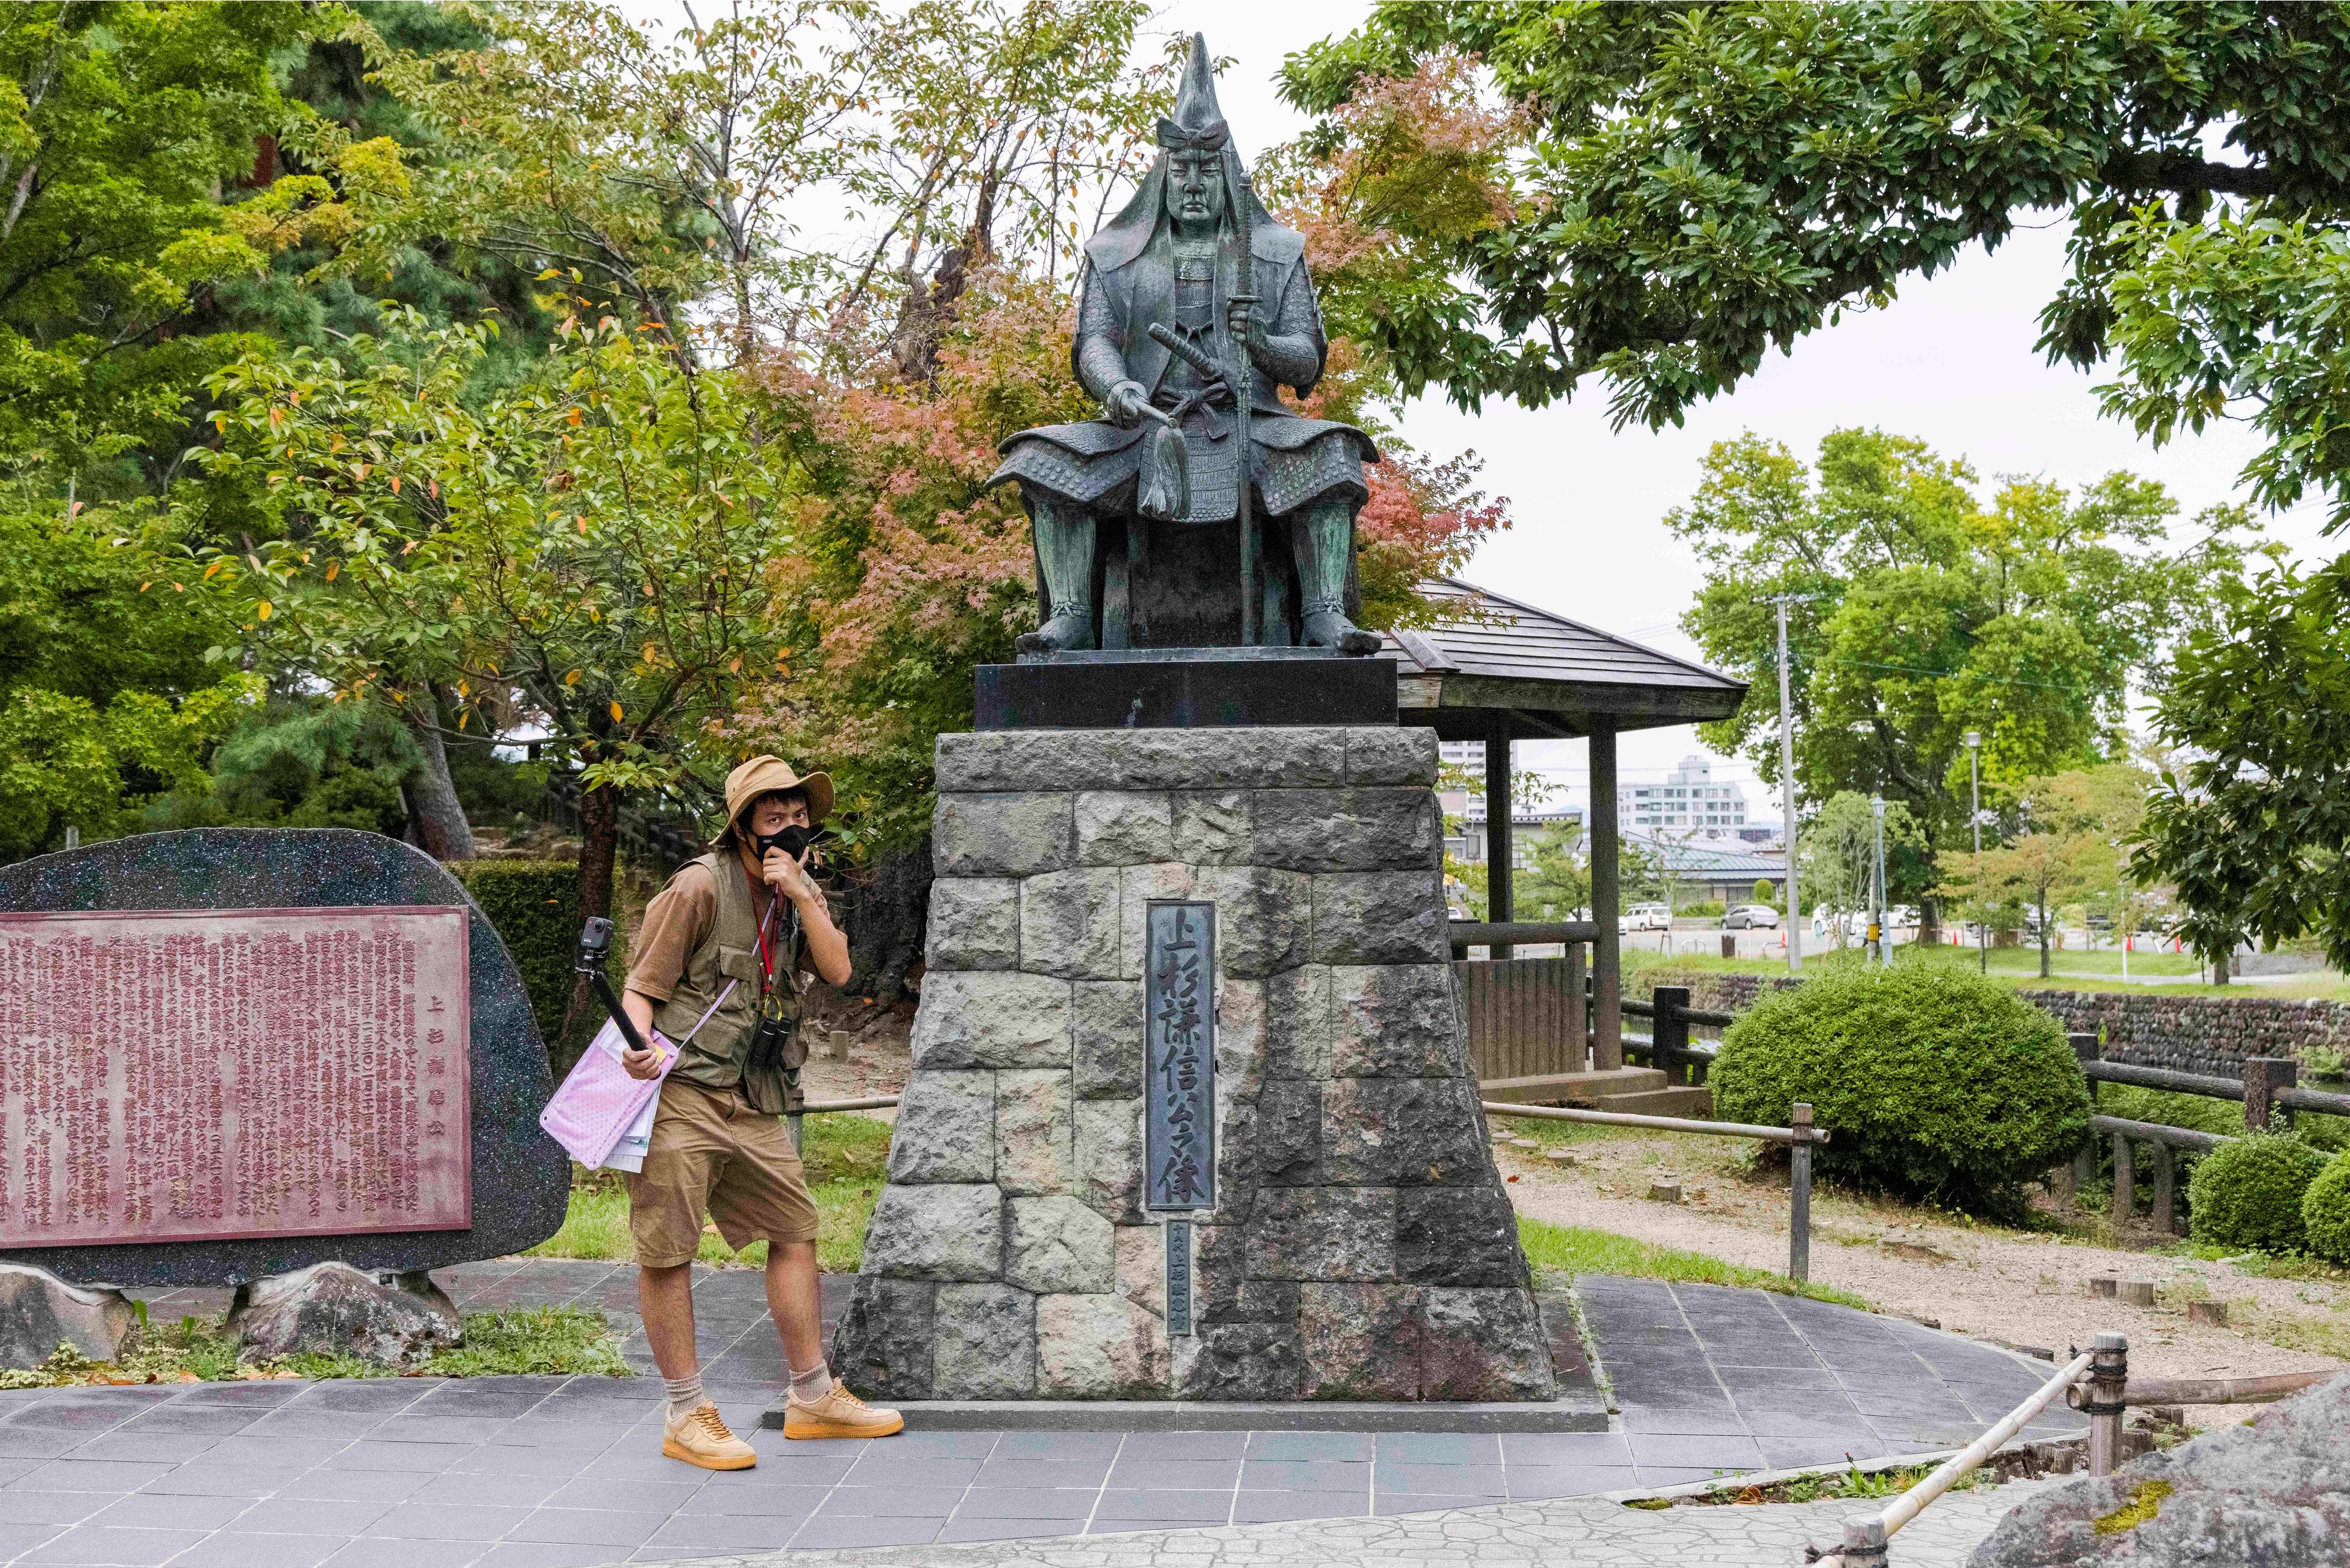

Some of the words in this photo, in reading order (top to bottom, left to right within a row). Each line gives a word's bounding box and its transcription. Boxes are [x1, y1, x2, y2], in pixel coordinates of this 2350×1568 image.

[426, 995, 445, 1136] 上杉謙信公
[1157, 908, 1205, 1203] 上杉謙信公之像
